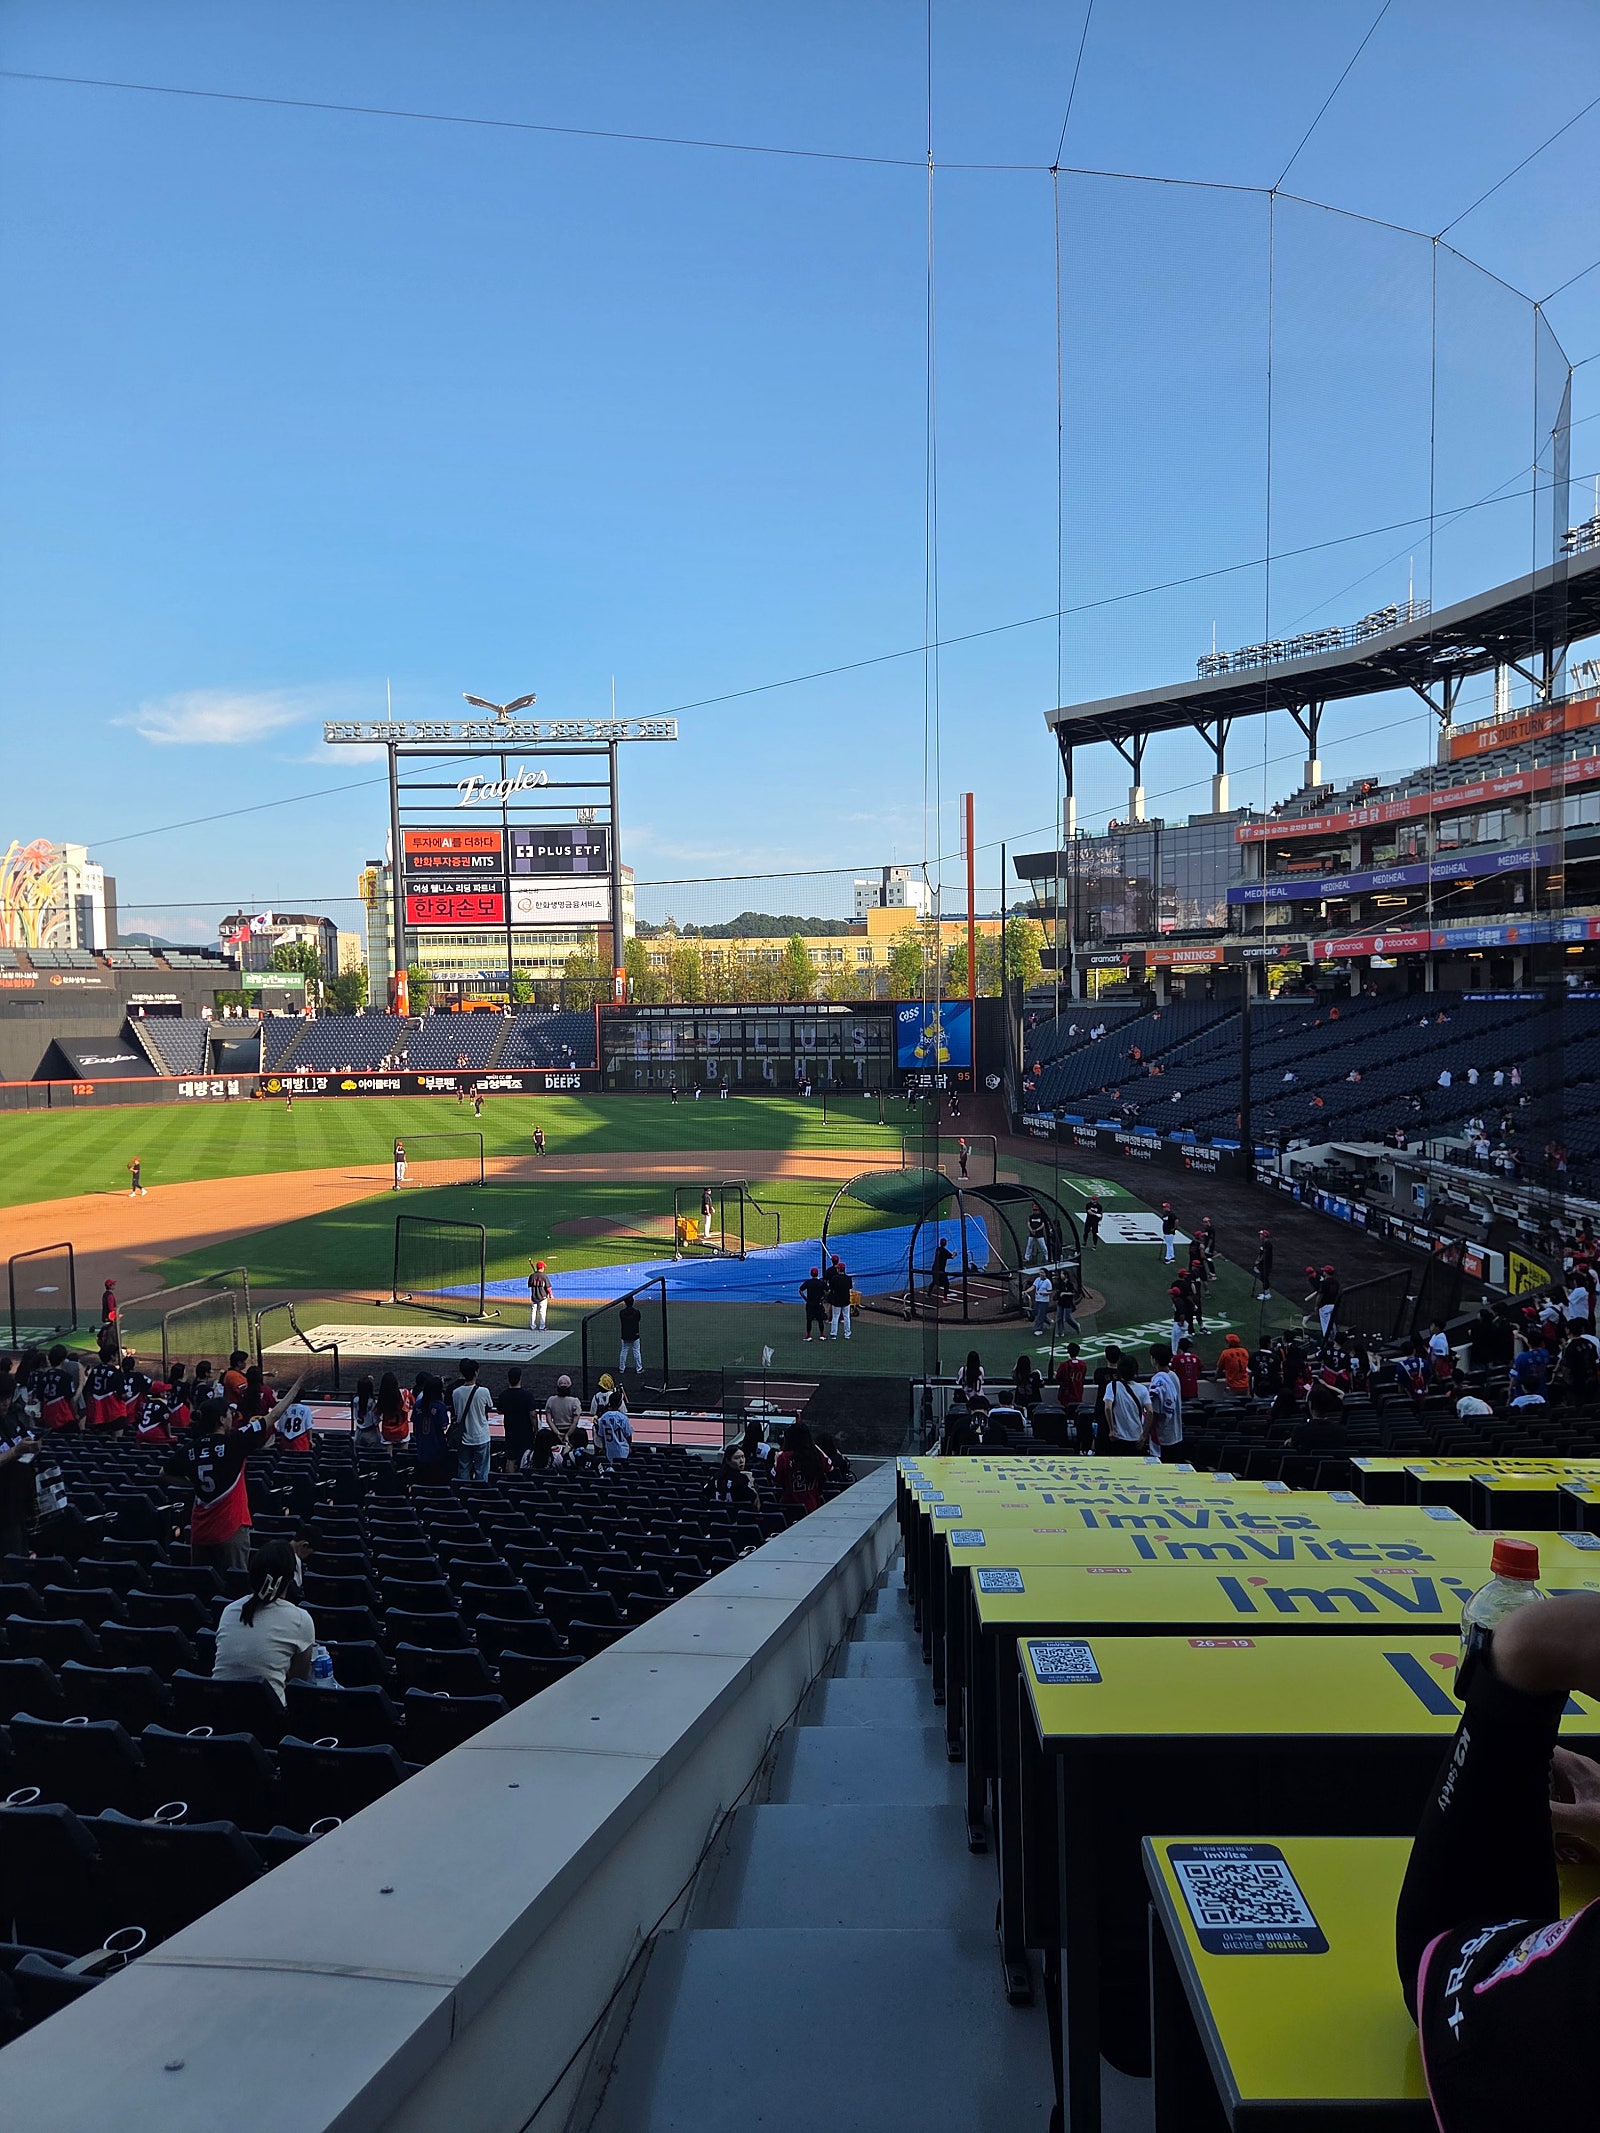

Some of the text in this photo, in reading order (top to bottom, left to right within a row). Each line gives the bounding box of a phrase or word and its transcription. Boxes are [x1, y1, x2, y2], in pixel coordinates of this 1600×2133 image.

[1498, 726, 1518, 743] OUR
[1520, 717, 1545, 738] TURN
[456, 764, 550, 808] Eagles
[412, 836, 494, 848] 투자에AI를 더하다
[538, 845, 601, 856] PLUS ETF
[1497, 851, 1541, 867] MEDIHEAL
[1431, 862, 1468, 876] MEDIHEAL
[1372, 871, 1406, 885] MEDIHEAL
[413, 884, 428, 893] 여성
[456, 883, 471, 893] 리딩
[472, 883, 497, 893] 파트너
[1244, 887, 1288, 899] MEDIHEAL
[1320, 880, 1351, 893] MEDIHEAL
[414, 898, 497, 918] 한화손보
[535, 899, 603, 909] 한화생명금융서비스
[1333, 941, 1364, 951] roborock
[1384, 937, 1418, 948] roborock
[1172, 950, 1217, 962] INNINGS
[1242, 946, 1279, 957] aramark
[1090, 953, 1121, 964] aramark
[898, 1006, 920, 1023] Cass
[705, 1027, 866, 1050] PLUS
[79, 1053, 139, 1067] Eagles
[634, 1069, 677, 1081] PLUS
[957, 1072, 971, 1081] 95
[178, 1080, 241, 1098] 대방건설
[545, 1077, 581, 1089] DEEPS
[72, 1084, 95, 1096] 122
[142, 1410, 153, 1426] 5
[284, 1417, 303, 1434] 48
[196, 1463, 217, 1494] 5
[1436, 1726, 1472, 1813] K2 safety
